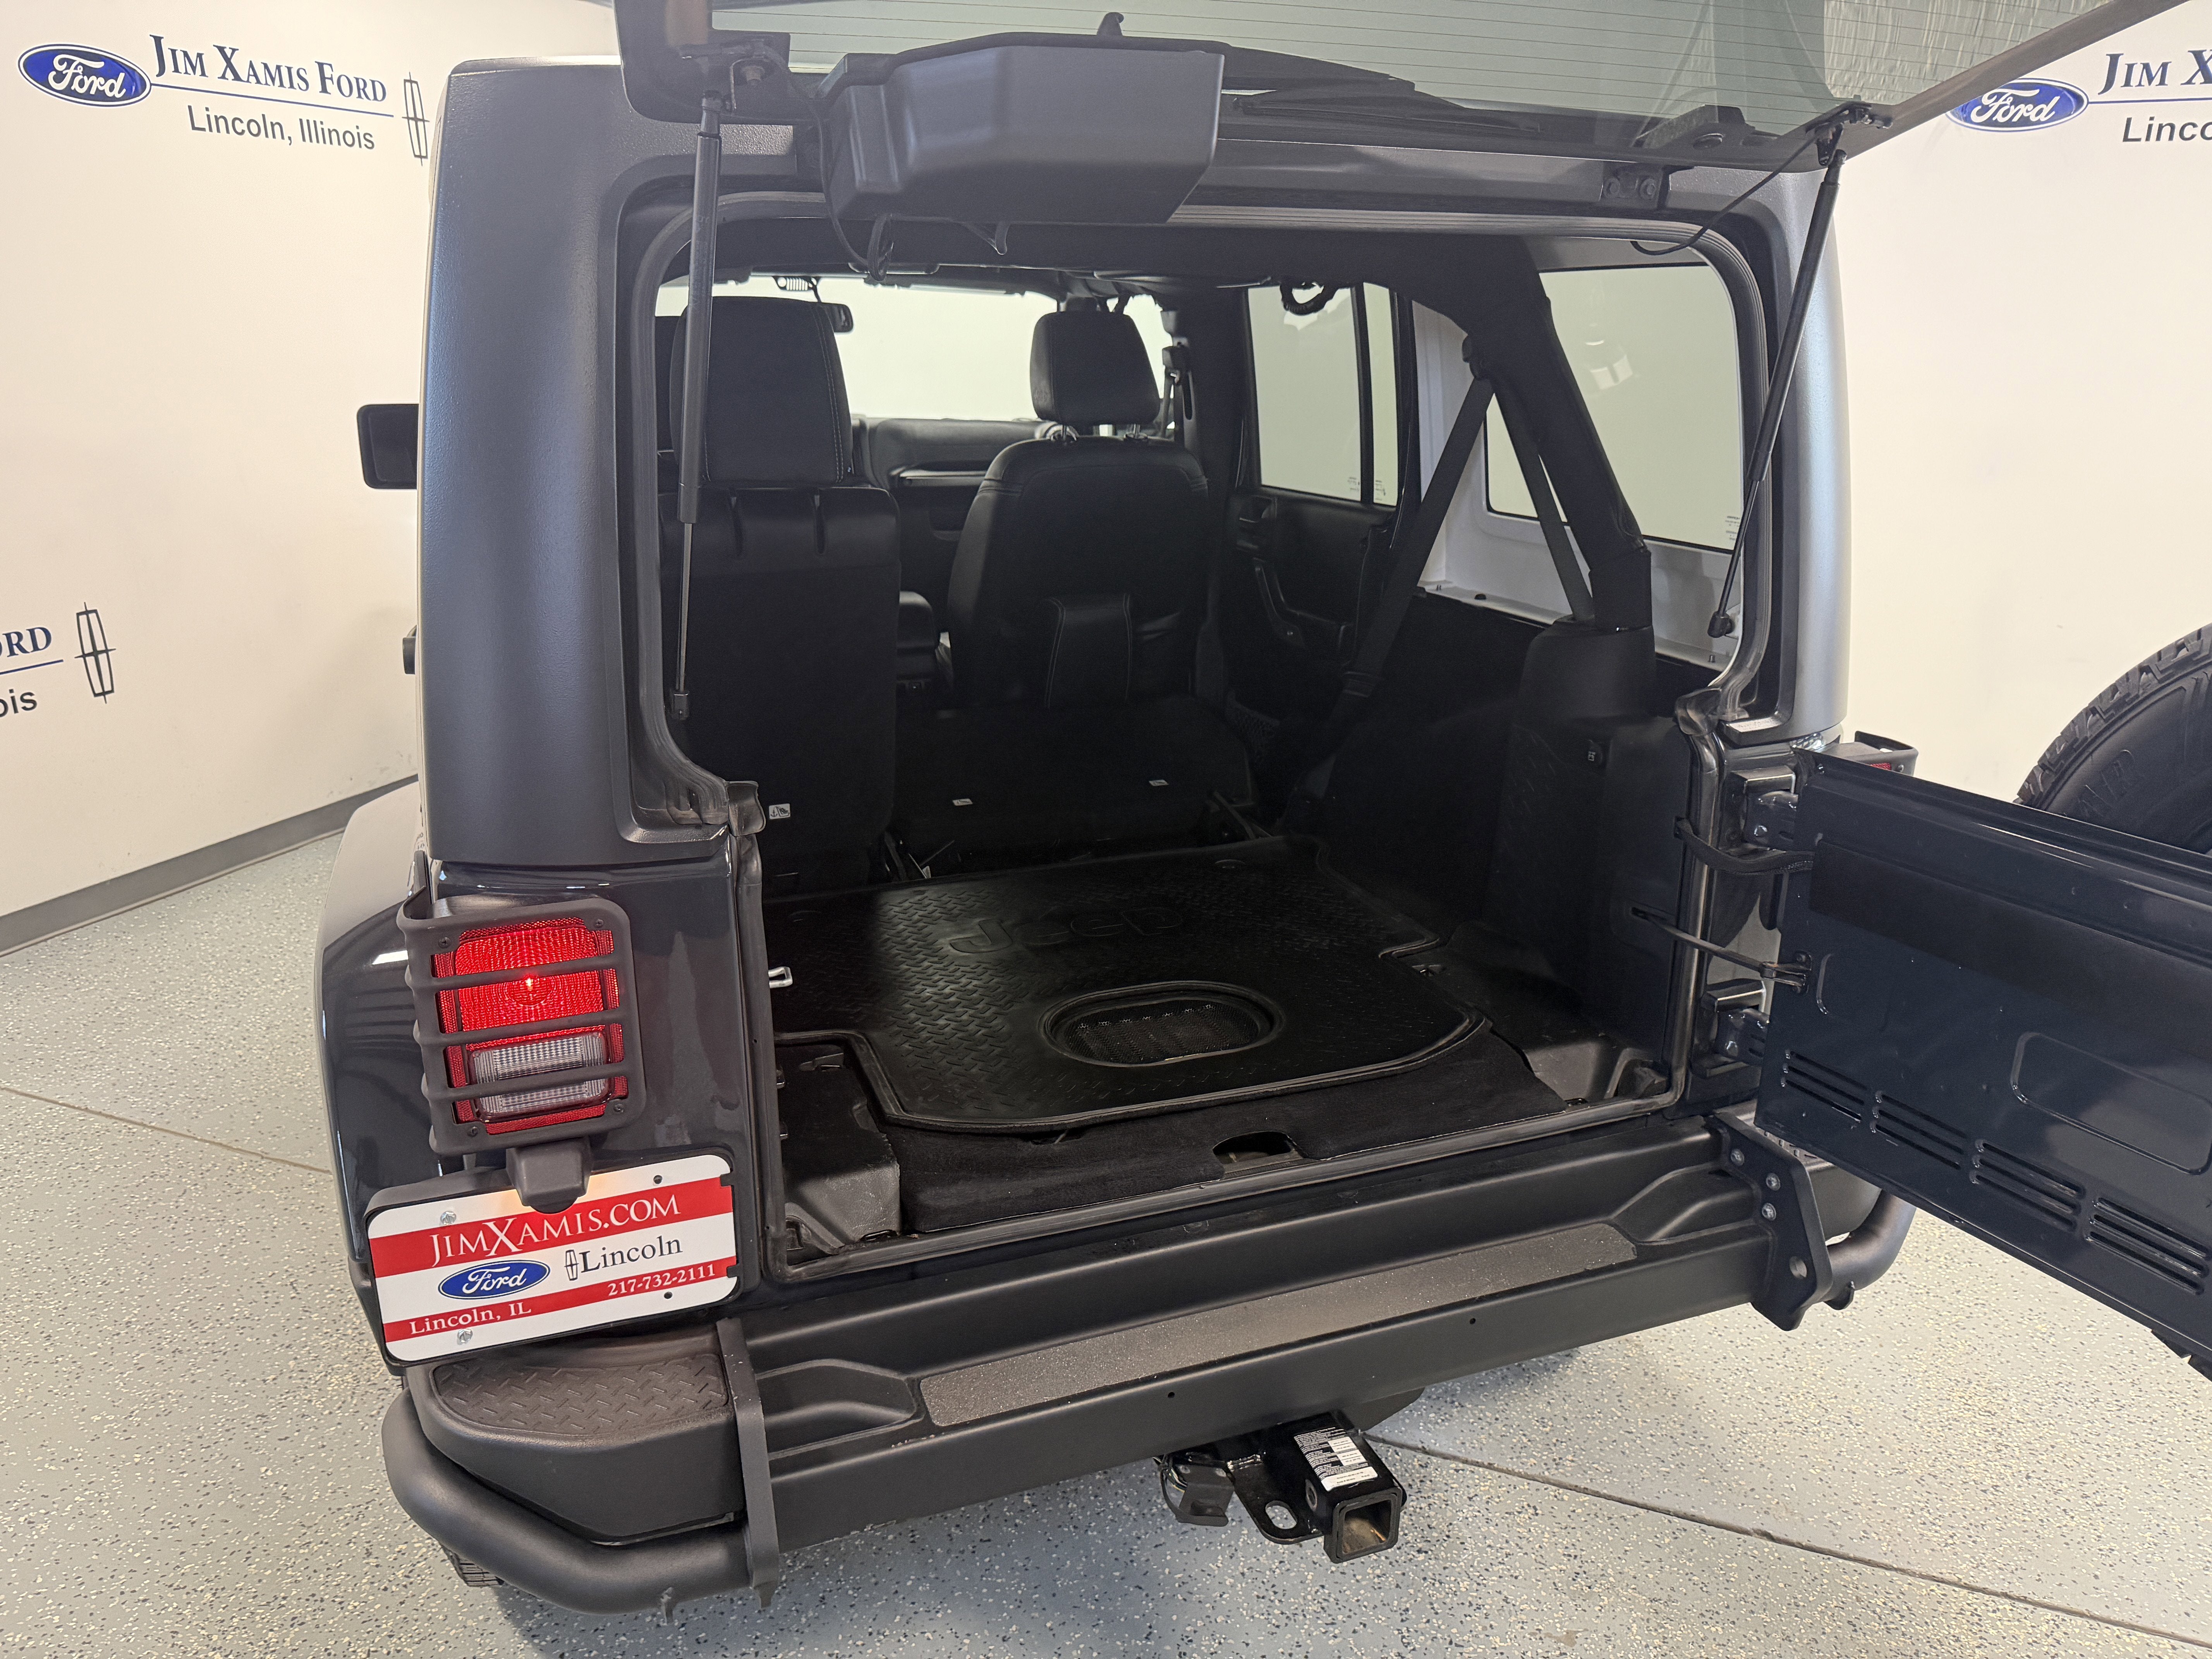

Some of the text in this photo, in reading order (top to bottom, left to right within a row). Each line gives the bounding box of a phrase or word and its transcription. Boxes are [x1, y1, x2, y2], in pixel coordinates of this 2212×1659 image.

[48, 54, 127, 99] Ford
[149, 34, 386, 102] JIM XAMIS FORD
[2098, 53, 2172, 95] JIM
[1970, 88, 2061, 123] Ford
[187, 105, 375, 150] Lincoln, Illinois
[0, 627, 52, 658] RD
[429, 1194, 682, 1267] JIMXAMIS.COM
[580, 1236, 683, 1273] Lincoln
[409, 1263, 716, 1335] Lincoln, IL 217-732-2111
[462, 1266, 527, 1294] Ford
